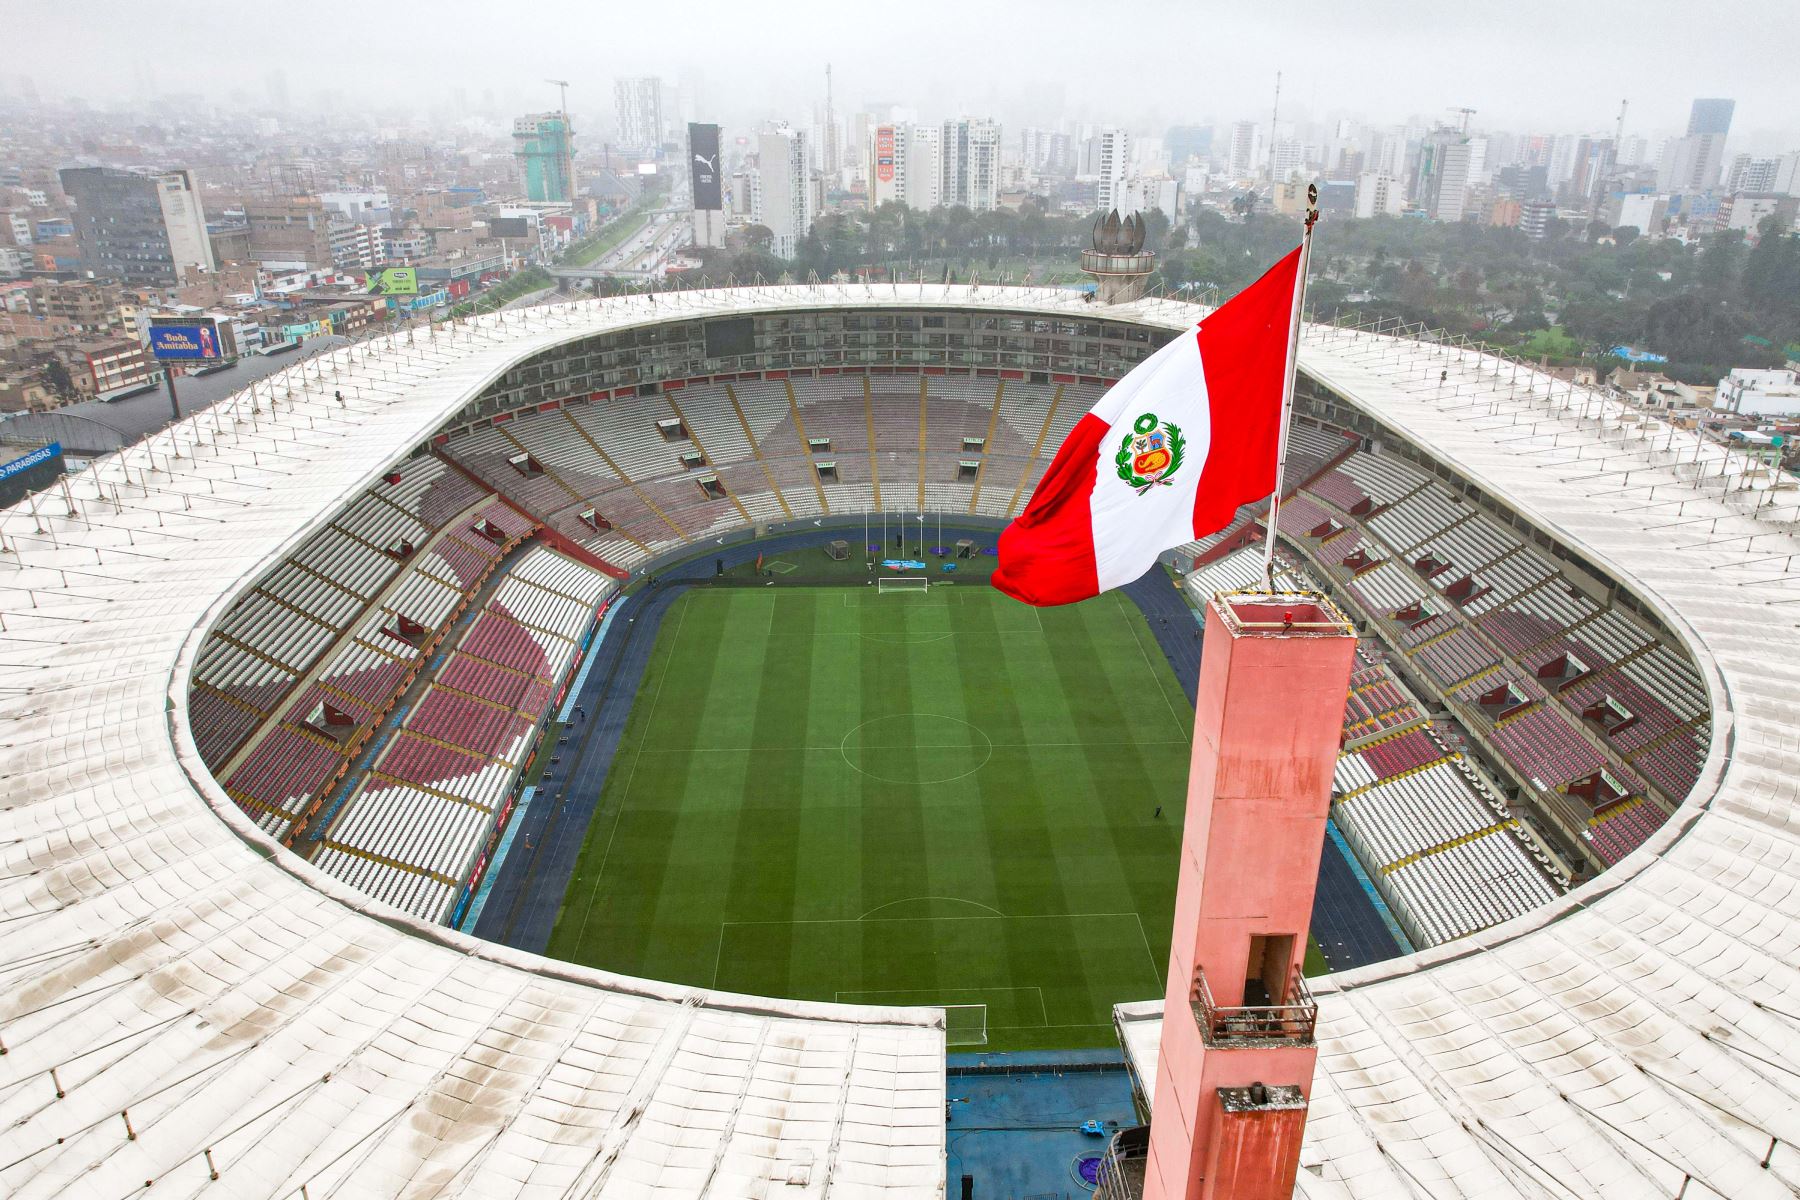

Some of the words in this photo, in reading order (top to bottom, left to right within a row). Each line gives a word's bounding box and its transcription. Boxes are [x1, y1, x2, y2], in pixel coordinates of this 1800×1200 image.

[163, 333, 187, 341] Buda
[156, 341, 198, 350] Amitabha
[6, 448, 51, 474] PARABRISAS
